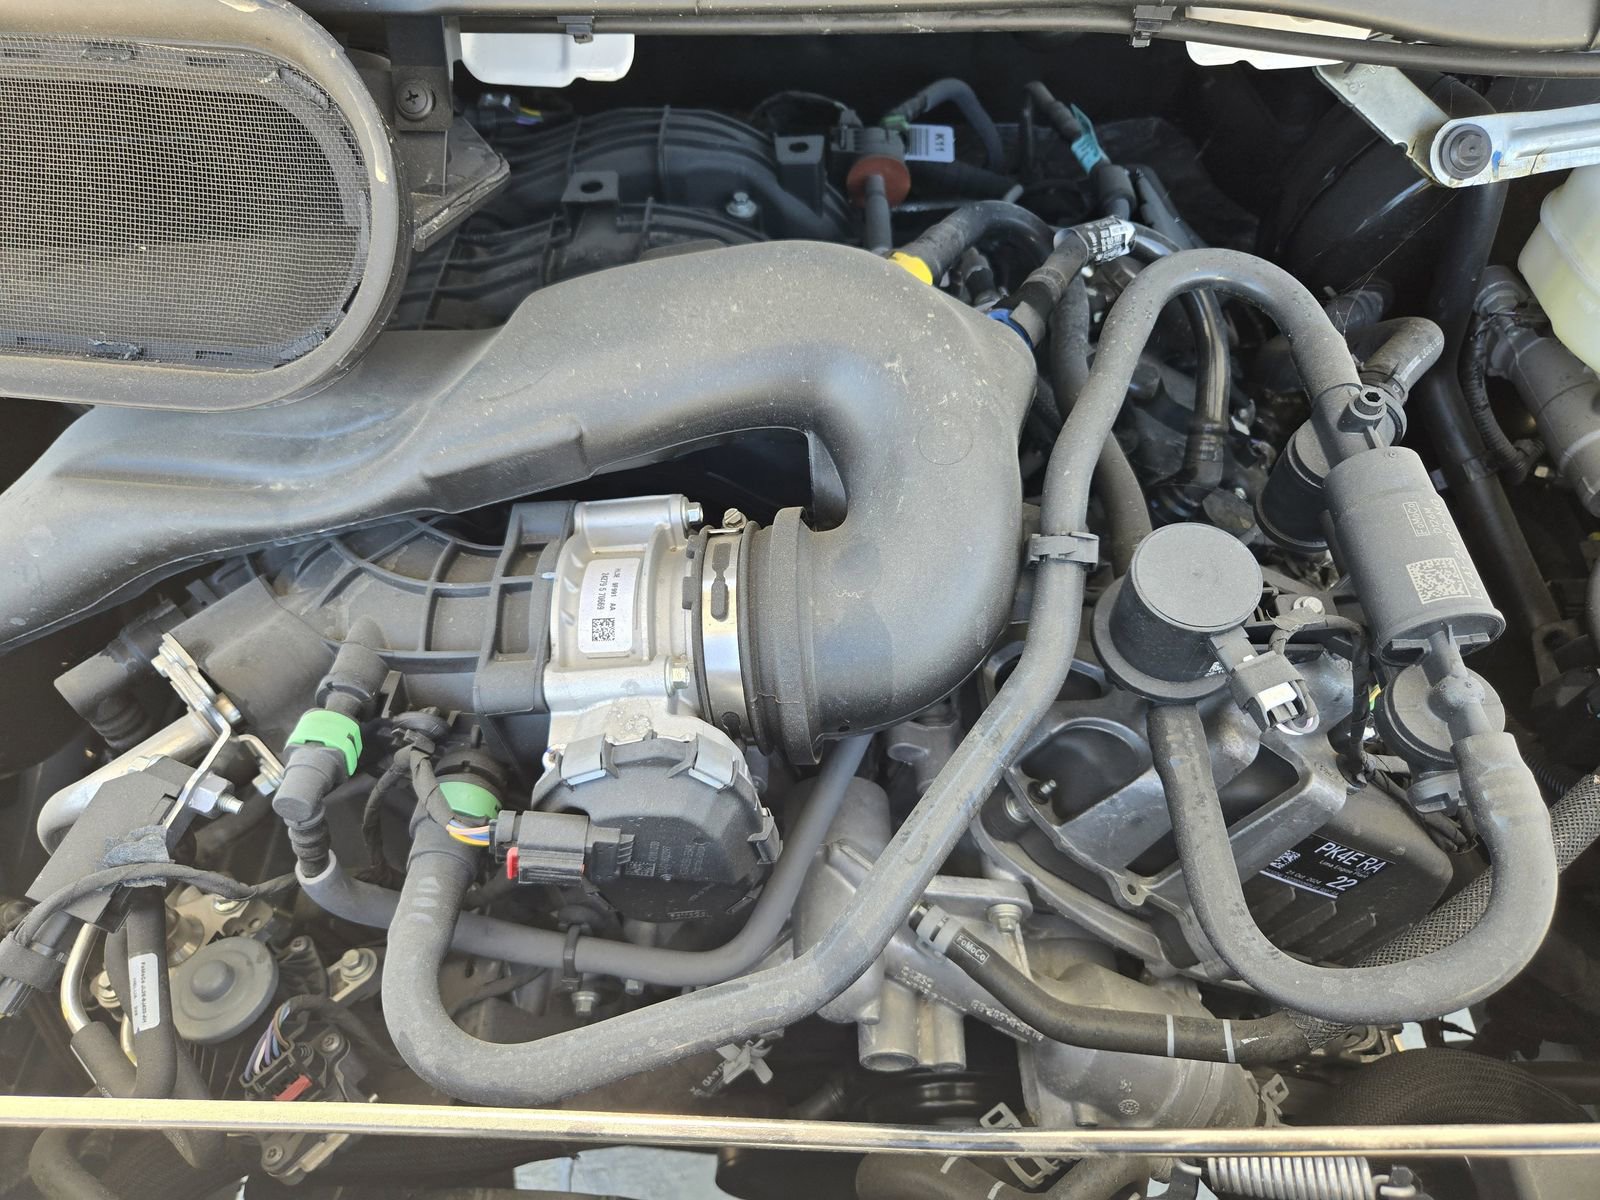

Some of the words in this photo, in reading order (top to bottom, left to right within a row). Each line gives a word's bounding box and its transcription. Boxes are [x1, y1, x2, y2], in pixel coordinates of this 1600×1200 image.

[1407, 503, 1428, 535] FoMoCo
[609, 603, 616, 611] AA
[1314, 842, 1365, 865] PK4E
[1356, 856, 1387, 874] RA
[1325, 875, 1358, 891] 22
[956, 934, 986, 961] FoMoCo
